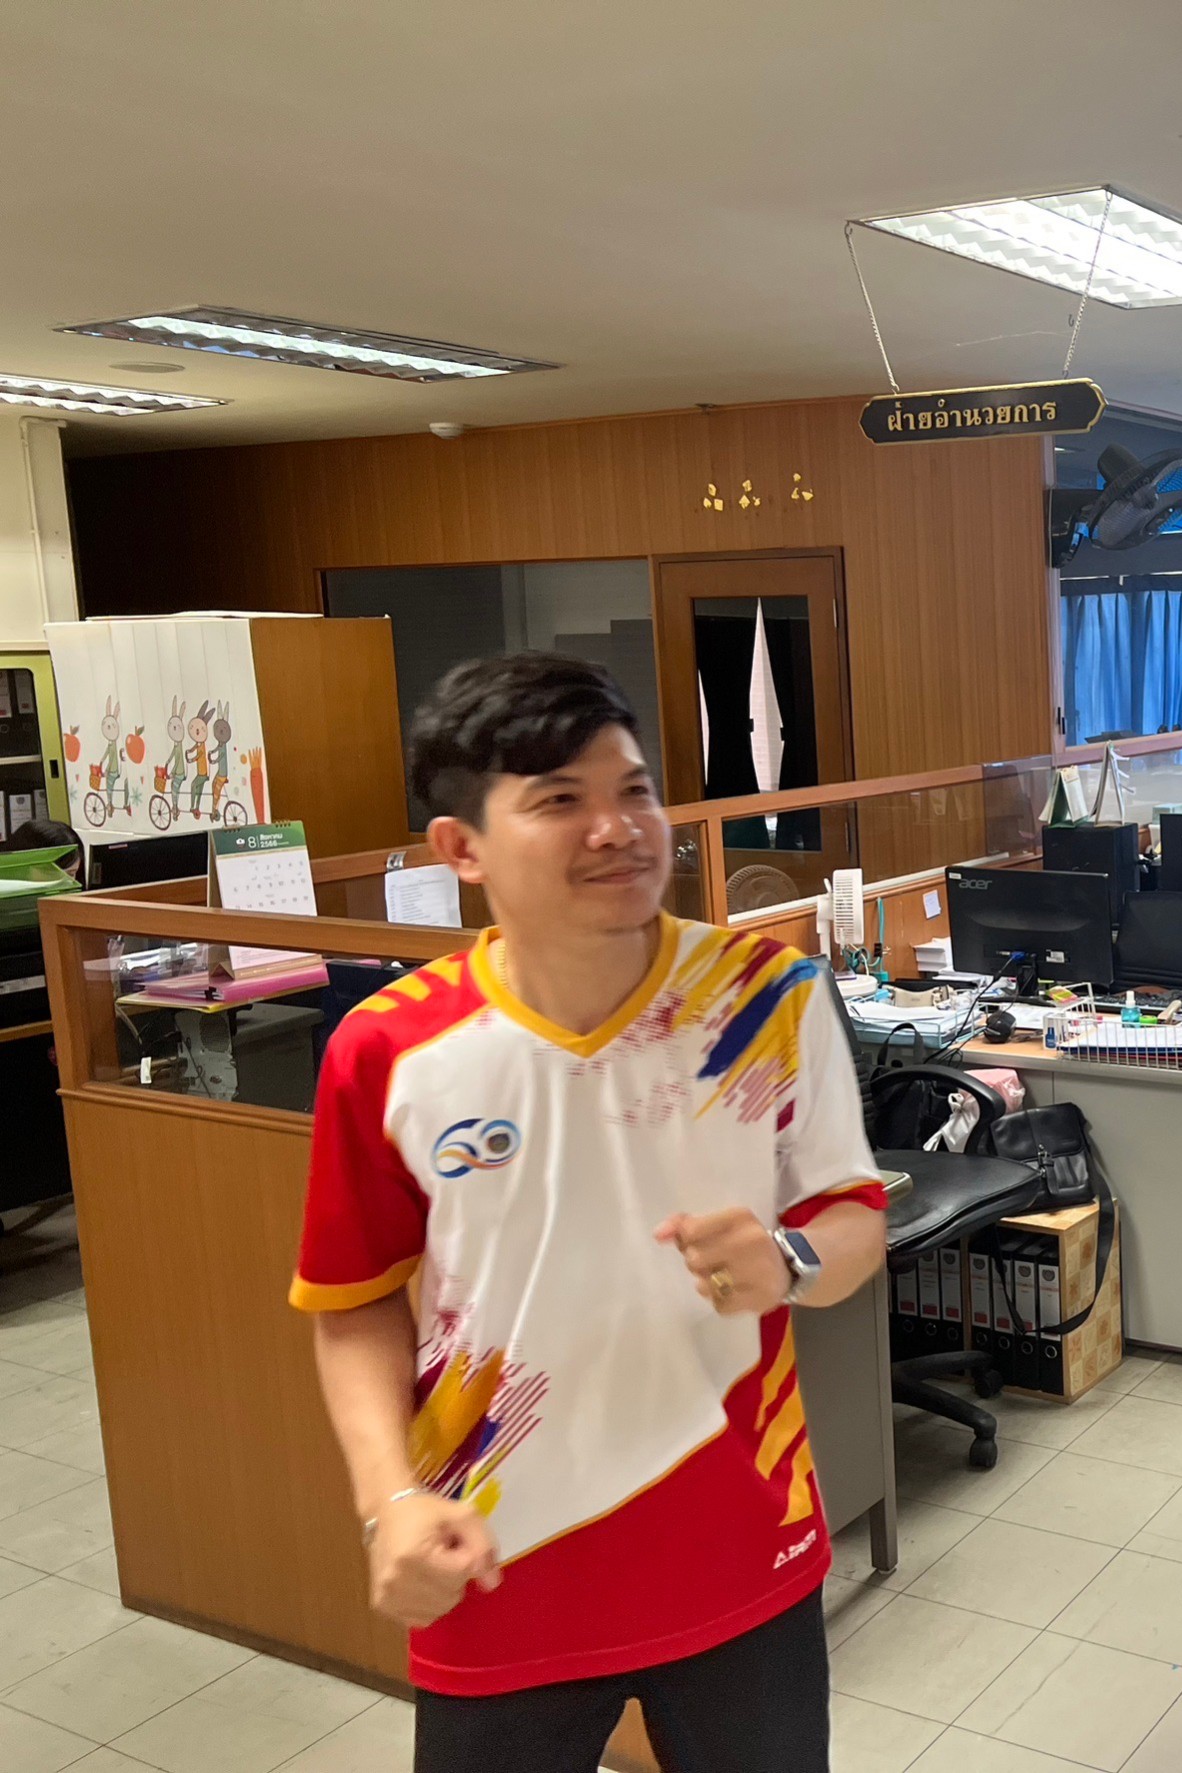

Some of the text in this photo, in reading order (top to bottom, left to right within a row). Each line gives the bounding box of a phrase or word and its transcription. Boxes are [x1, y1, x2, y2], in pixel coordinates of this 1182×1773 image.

[886, 398, 1058, 432] ฝ่ายอำนวยการ
[958, 878, 993, 890] acer
